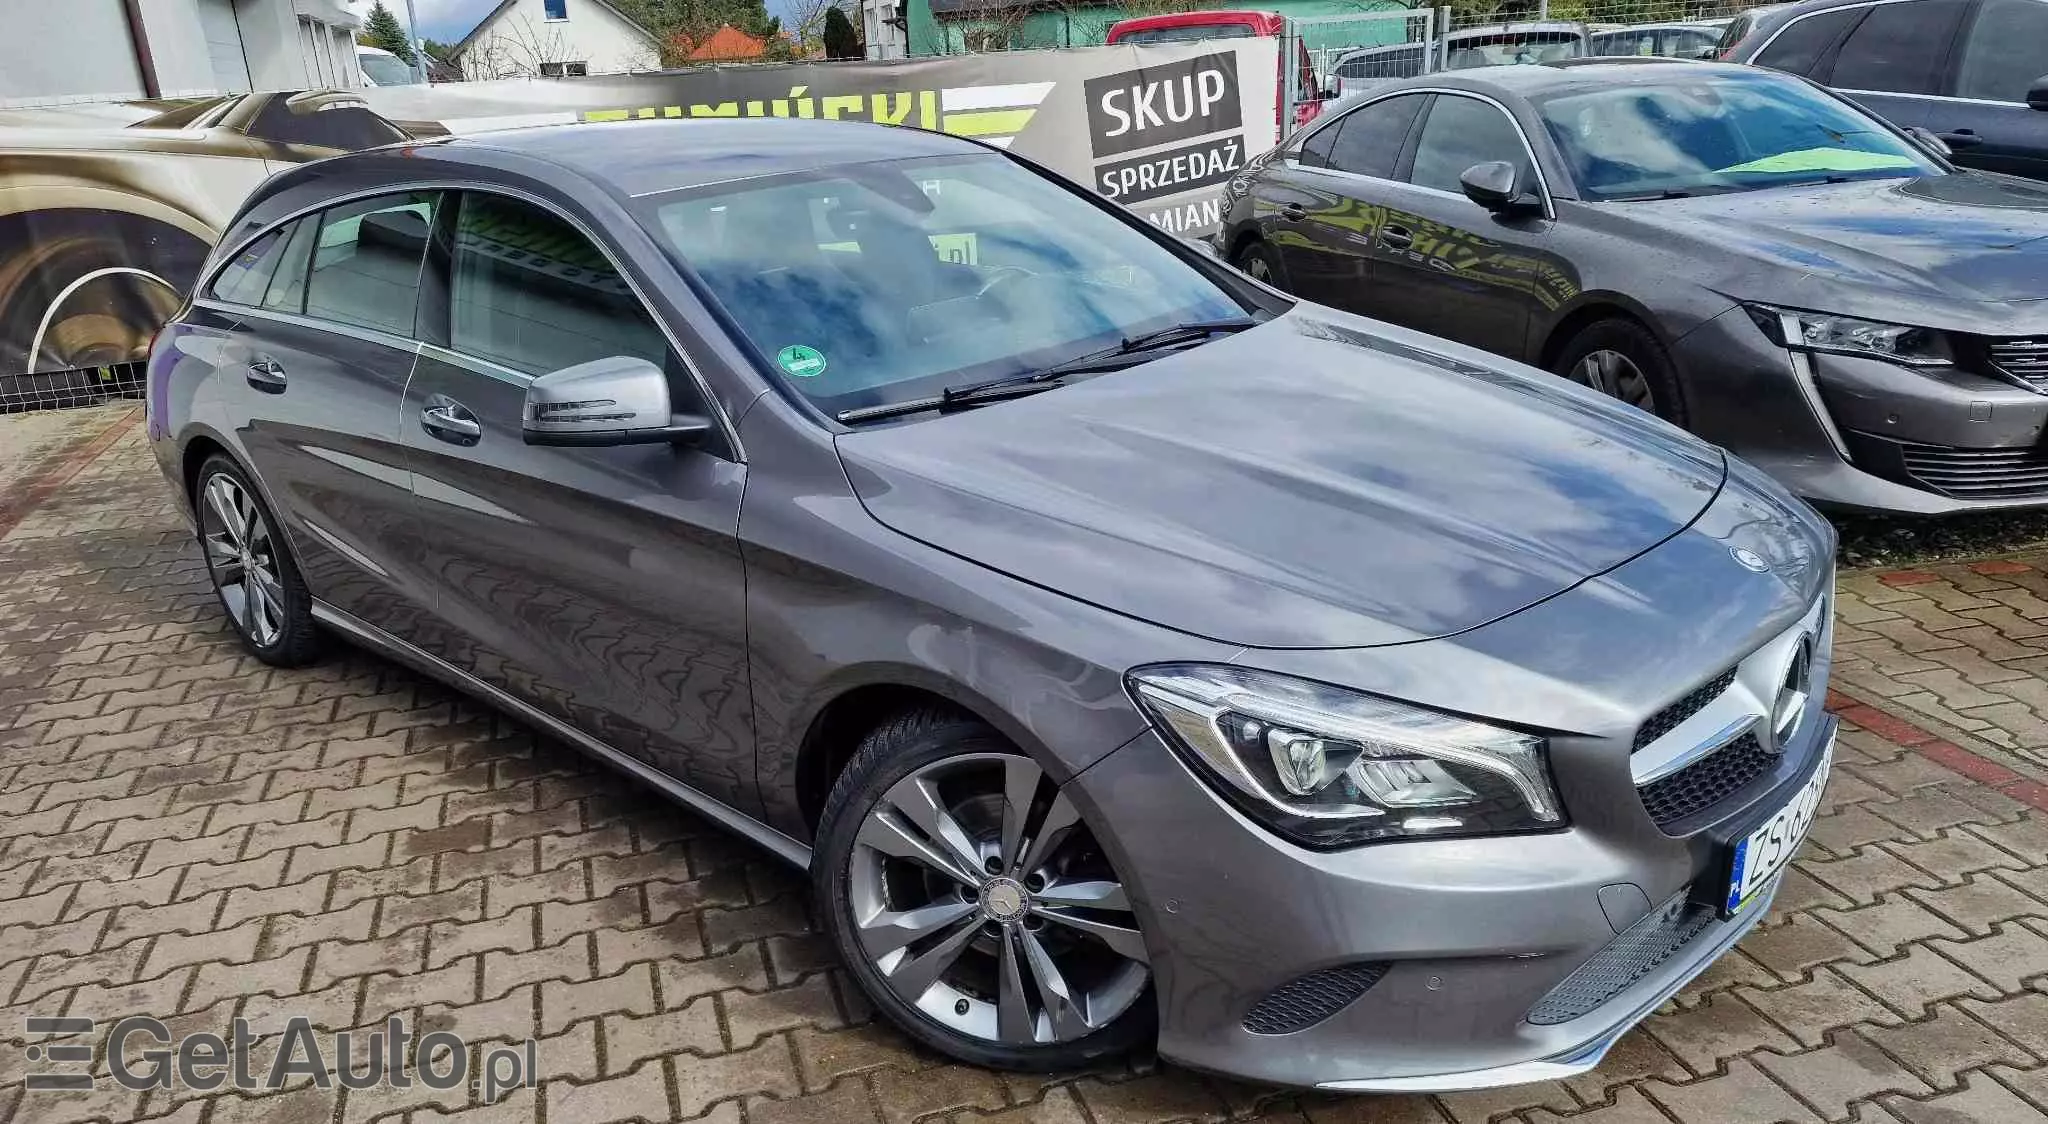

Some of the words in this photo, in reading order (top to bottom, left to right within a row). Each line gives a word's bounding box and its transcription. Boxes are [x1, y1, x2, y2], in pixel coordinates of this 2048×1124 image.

[1101, 69, 1225, 136] SKUP
[1102, 138, 1240, 198] SPRZEDAŻ
[1149, 199, 1220, 234] MIAN
